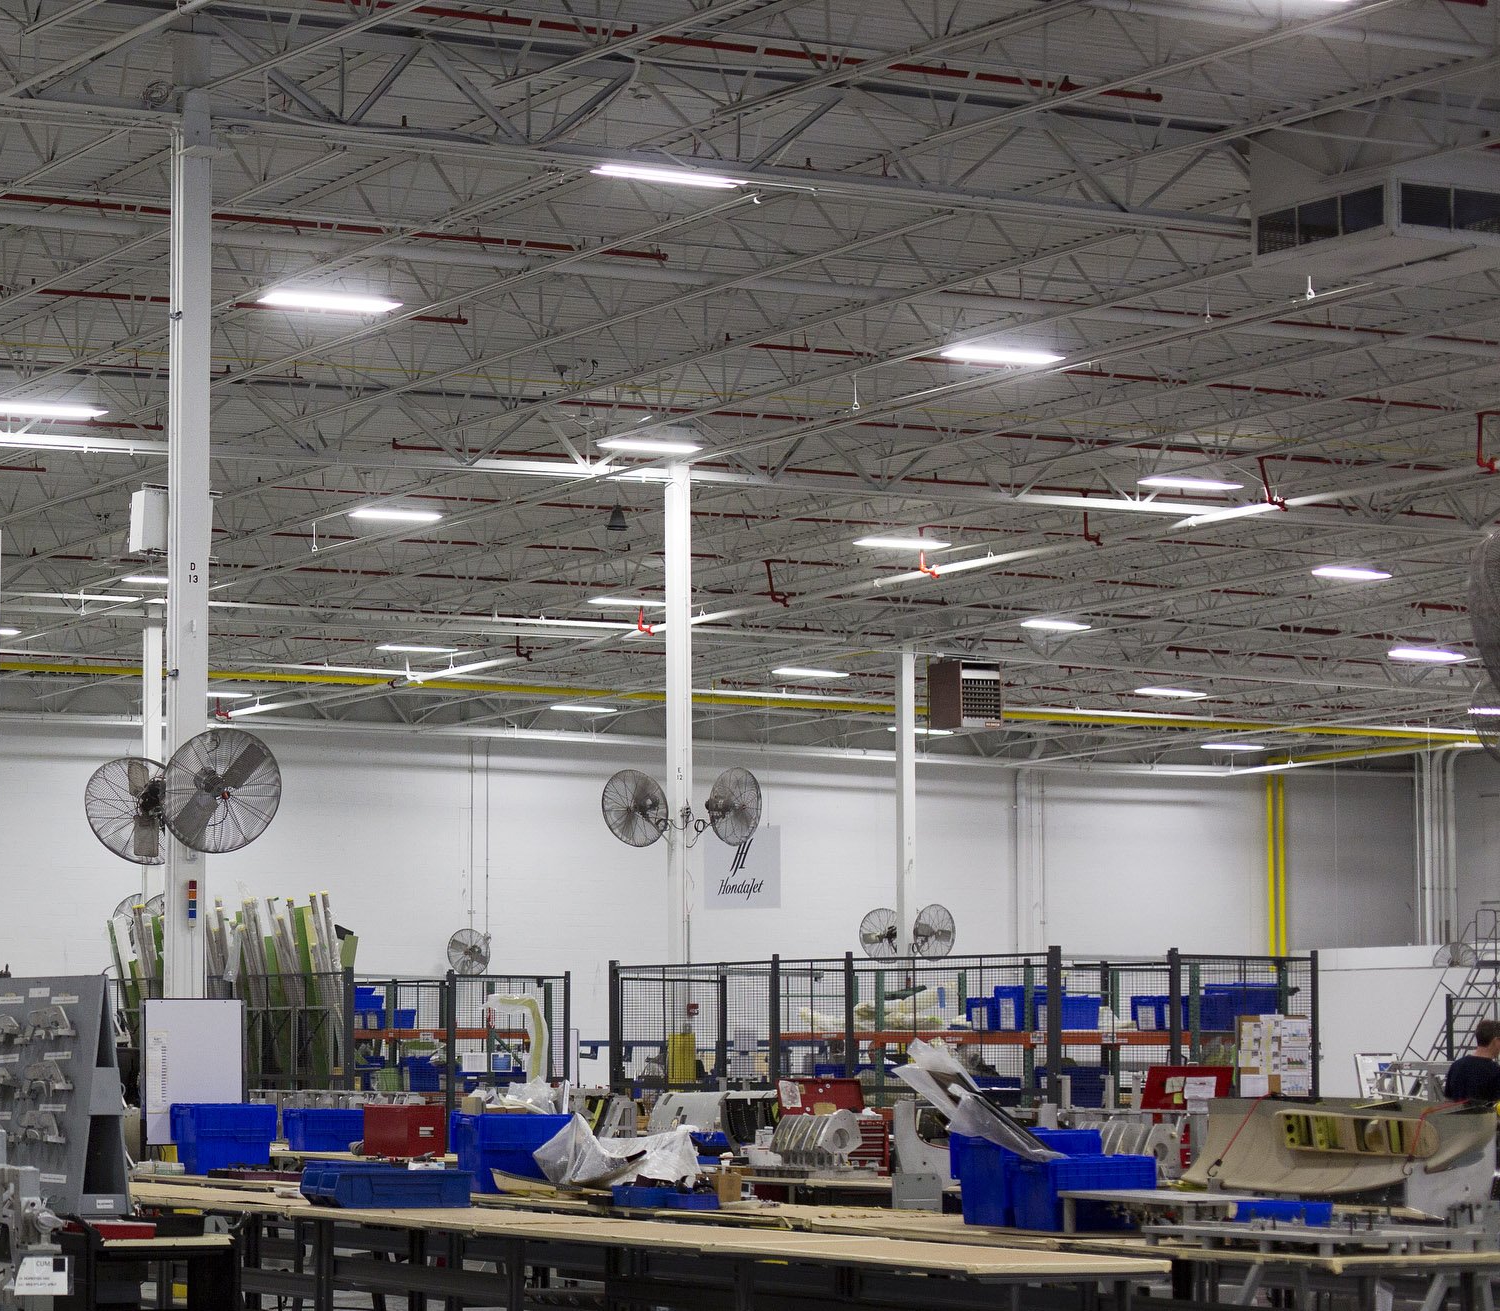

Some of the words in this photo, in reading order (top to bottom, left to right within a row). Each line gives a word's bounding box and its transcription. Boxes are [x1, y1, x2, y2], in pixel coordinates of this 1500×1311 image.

[190, 562, 196, 571] D
[188, 574, 199, 584] 13
[717, 876, 764, 901] HondaJet
